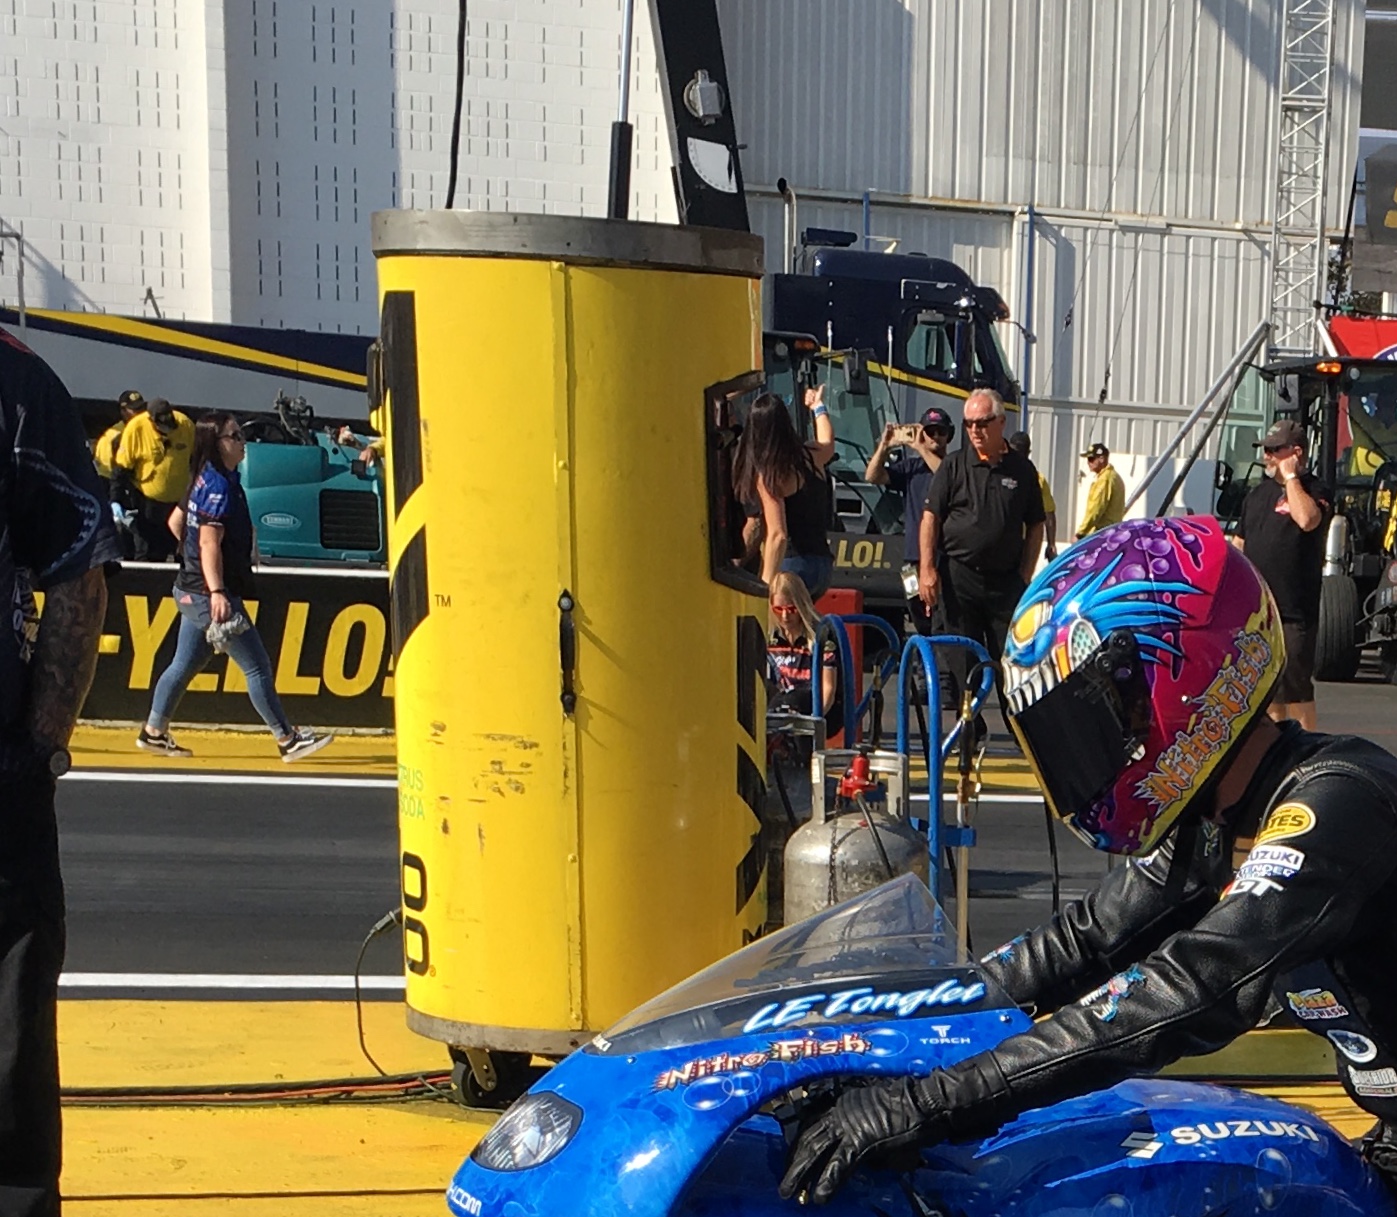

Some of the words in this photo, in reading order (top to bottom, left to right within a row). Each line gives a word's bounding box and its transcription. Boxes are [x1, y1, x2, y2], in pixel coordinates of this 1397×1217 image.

[822, 977, 986, 1018] Tonglet
[1320, 1005, 1348, 1018] WASH
[919, 1035, 971, 1046] TORCH
[653, 1051, 769, 1093] Nitro
[770, 1032, 872, 1061] Fish
[1169, 1120, 1320, 1146] SUZUKI
